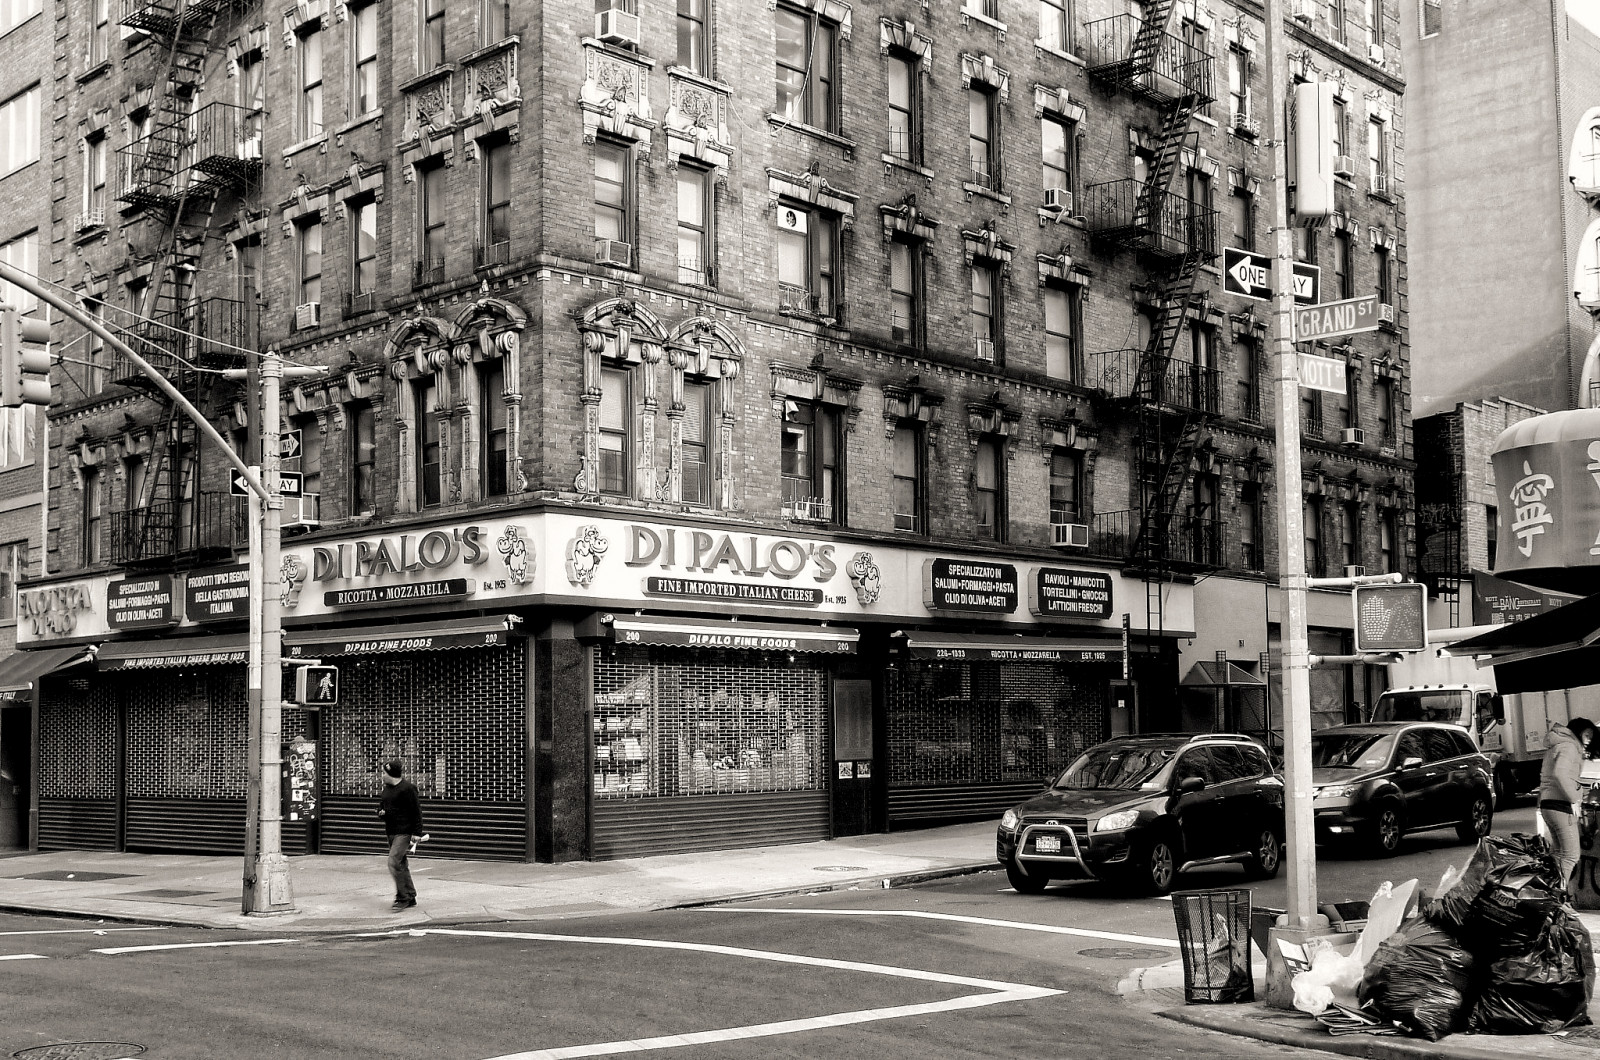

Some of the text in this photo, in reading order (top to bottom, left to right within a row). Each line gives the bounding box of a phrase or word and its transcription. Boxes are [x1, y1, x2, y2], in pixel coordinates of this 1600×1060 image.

[1239, 265, 1306, 294] ONE AY
[1299, 300, 1374, 337] GRAND ST
[1298, 358, 1344, 387] MOTT ST
[281, 439, 296, 451] WAY
[279, 479, 294, 491] AY
[1510, 460, 1555, 558] 寧
[313, 526, 489, 582] DI PALO'S
[624, 525, 837, 583] DI PALO'S
[188, 570, 250, 588] PRODOTTI TIPICI REGION
[948, 564, 1002, 579] SPECIALIZZATO IN
[119, 580, 160, 595] SPECIALIZZATO IN
[1045, 574, 1105, 589] RAVIOLI MANICOTTI
[195, 587, 249, 603] DELLA GASTRONOMIA
[338, 582, 450, 604] RICOTTA MOZZARELLA
[658, 579, 814, 602] FINE IMPORTED ITALIAN CHEESE
[945, 592, 960, 604] OLIO
[961, 594, 967, 604] DI
[1042, 587, 1109, 602] TORTELLINI GNOCCHI
[19, 584, 92, 619] ENOTECA
[210, 601, 234, 614] ITALIANA
[1048, 600, 1104, 614] LATTICINI FRESCHI
[116, 611, 127, 622] OLIO
[127, 611, 133, 621] DI
[485, 634, 498, 643] 200
[626, 631, 640, 641] 200
[734, 636, 758, 647] FINE
[761, 637, 797, 648] FOODS
[291, 646, 302, 655] 200
[378, 640, 399, 650] FINE
[400, 638, 432, 649] FOODS
[837, 642, 849, 651] 200
[136, 658, 164, 666] IMPORTED
[164, 656, 187, 664] ITALIAN
[187, 655, 211, 663] CHEESE
[210, 653, 229, 662] SINCE
[990, 650, 1060, 659] RICOTTA MOZZARELLA
